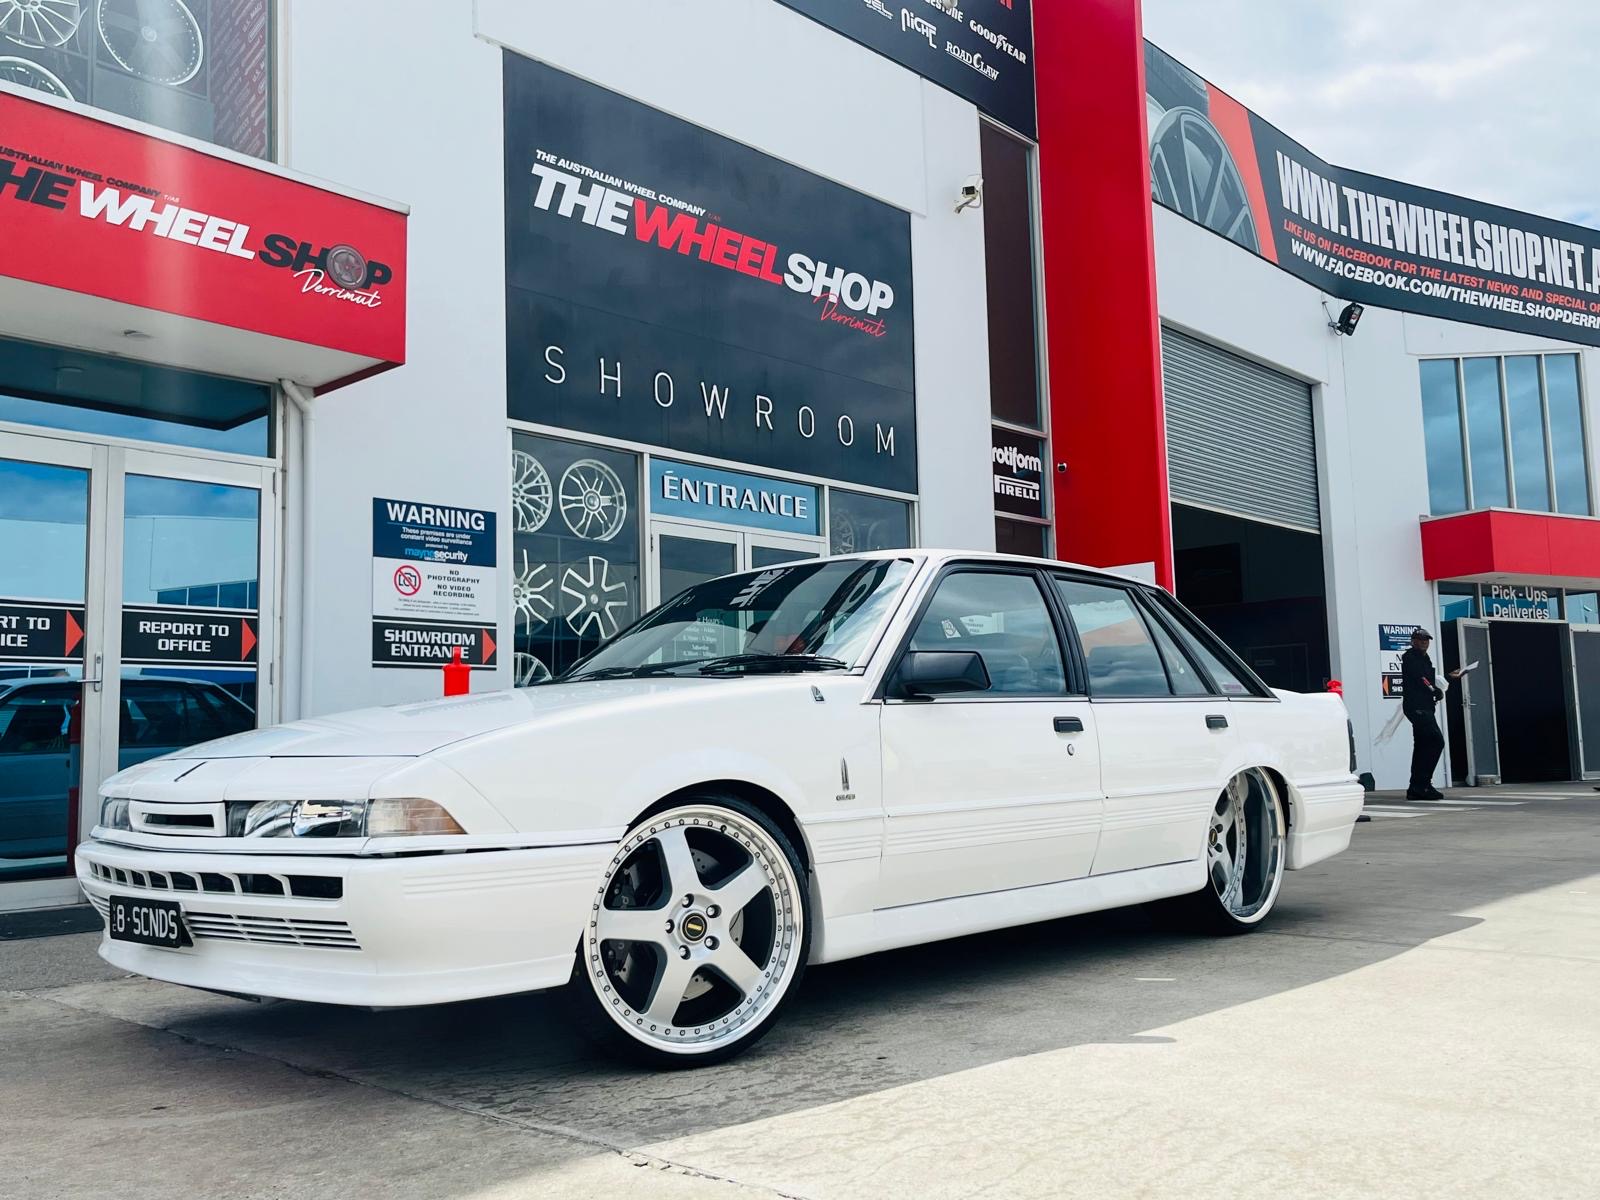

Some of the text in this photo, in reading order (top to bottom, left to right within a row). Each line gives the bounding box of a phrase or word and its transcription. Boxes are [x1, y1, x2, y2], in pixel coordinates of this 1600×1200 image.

[969, 19, 1027, 64] GOODYEAR
[66, 165, 104, 183] WHEEL
[106, 177, 161, 197] COMPANY
[535, 148, 557, 165] THE
[557, 159, 623, 188] AUSTRALIAN
[623, 181, 657, 201] WHEEL
[658, 193, 706, 217] COMPANY
[80, 180, 256, 260] WHEEL
[1283, 219, 1302, 238] LIKE
[1303, 228, 1316, 245] US
[1317, 237, 1332, 251] ON
[1332, 244, 1393, 270] FACEBOOK
[1394, 260, 1417, 275] FOR
[1420, 265, 1441, 279] THE
[1443, 270, 1485, 289] LATEST
[1487, 280, 1519, 296] NEWS
[1521, 287, 1543, 301] AND
[1545, 292, 1587, 311] SPECIAL
[293, 268, 382, 308] Derrimut
[783, 252, 894, 316] SHOP
[812, 292, 887, 337] Derrimut
[544, 345, 895, 457] SHOWROOM
[992, 446, 1042, 473] rotiform
[994, 474, 1040, 501] PIRELLI
[387, 502, 485, 531] WARNING
[401, 533, 424, 541] constant
[425, 535, 440, 543] video
[402, 526, 419, 535] These
[420, 529, 445, 538] premises
[427, 574, 480, 584] PHOTOGRAPHY
[433, 590, 475, 599] RECORDING
[1491, 585, 1516, 600] Pick
[1525, 586, 1548, 606] Ups
[26, 616, 50, 630] TO
[1493, 603, 1550, 619] Deliveries
[139, 620, 230, 637] REPORT TO
[384, 628, 476, 646] SHOWROOM
[157, 638, 211, 653] OFFICE
[391, 643, 470, 659] ENTRANE
